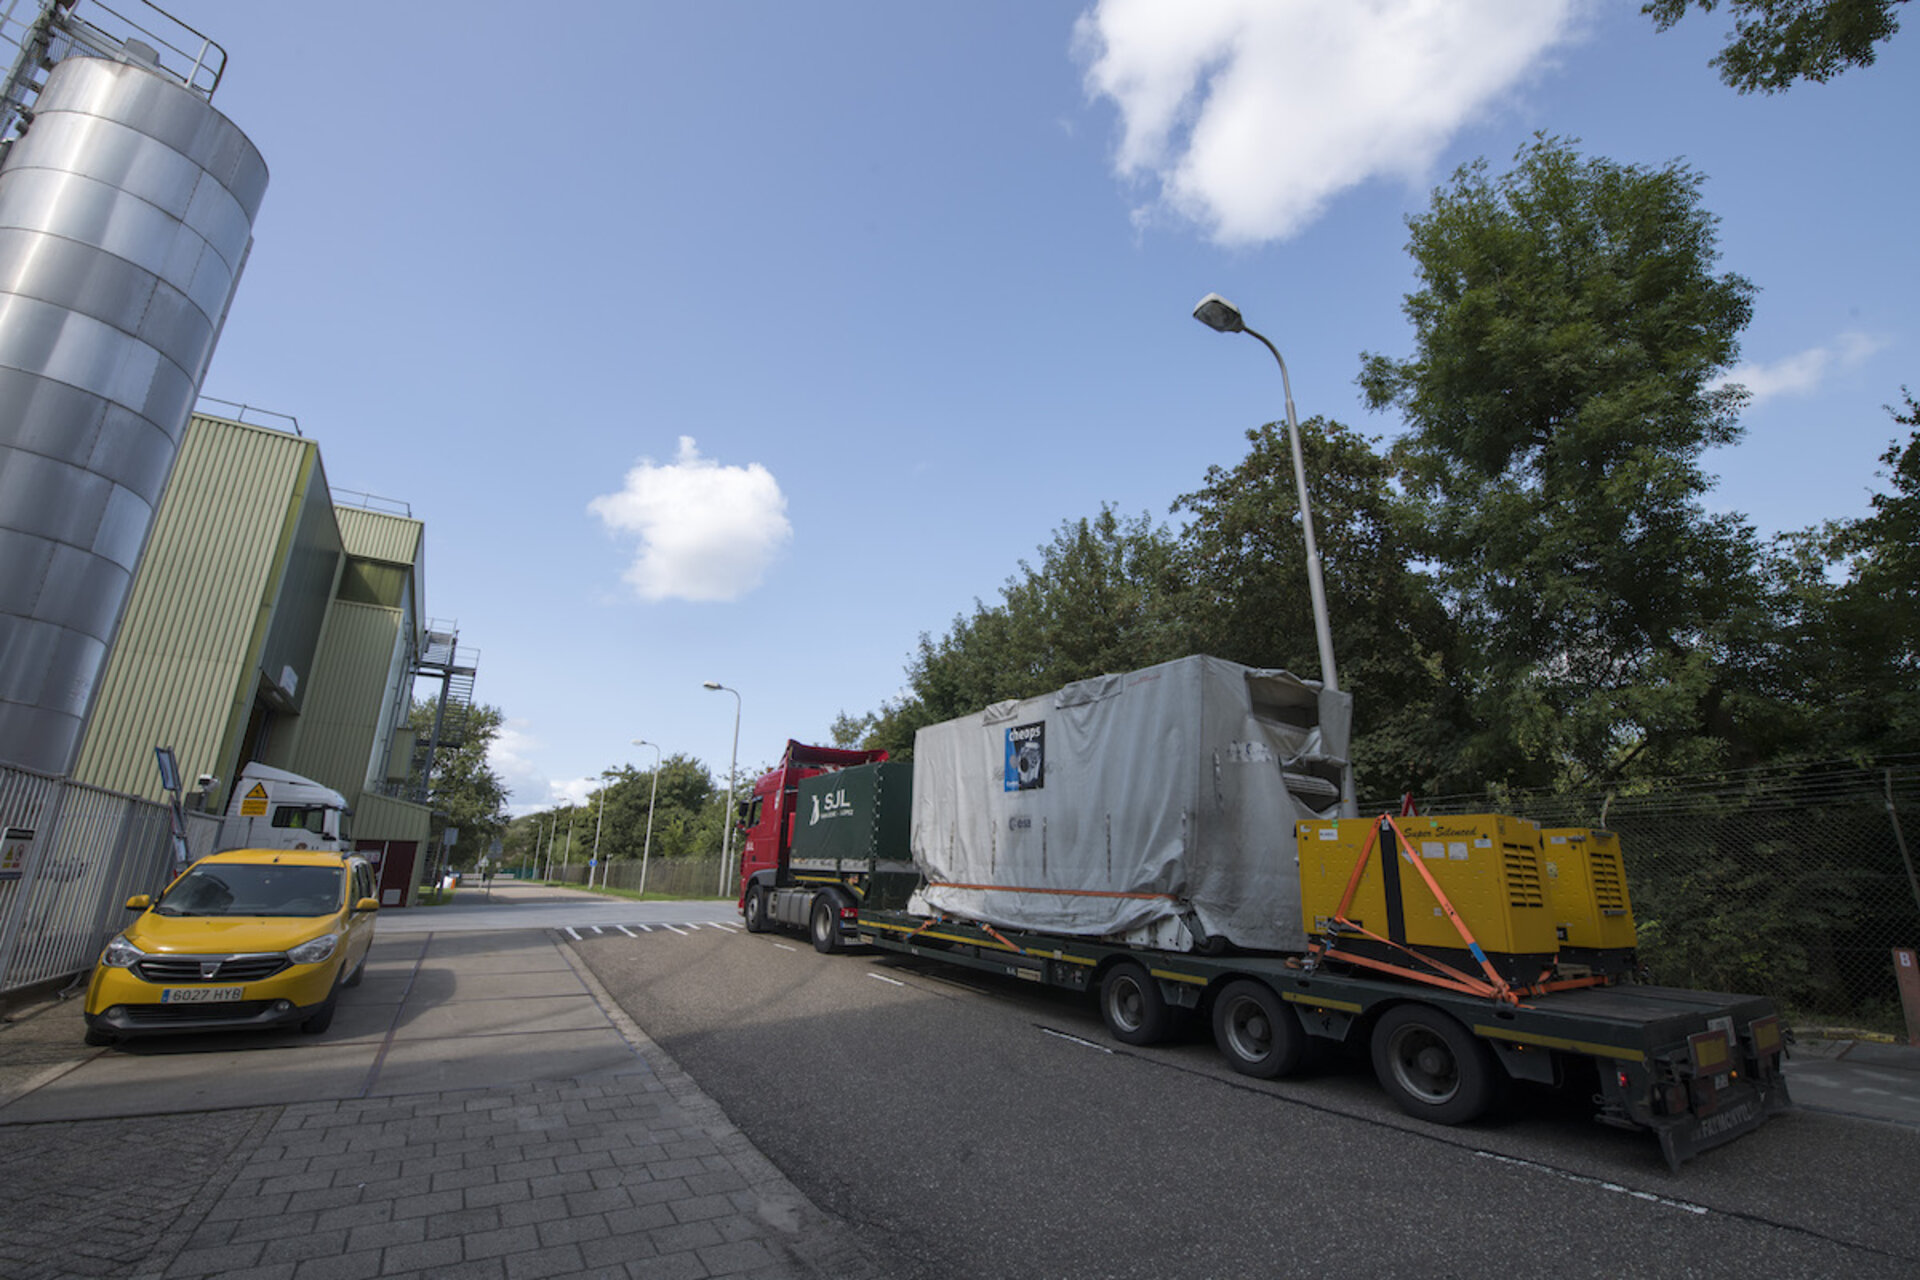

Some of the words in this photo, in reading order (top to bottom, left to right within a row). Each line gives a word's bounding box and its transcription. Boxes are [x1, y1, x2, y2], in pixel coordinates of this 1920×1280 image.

[1009, 726, 1041, 742] cheops
[824, 789, 851, 811] SJL
[1403, 828, 1431, 840] Super
[1435, 825, 1477, 838] Silenced
[1900, 951, 1911, 967] B
[172, 989, 210, 1001] 6027
[213, 988, 241, 1000] HYB
